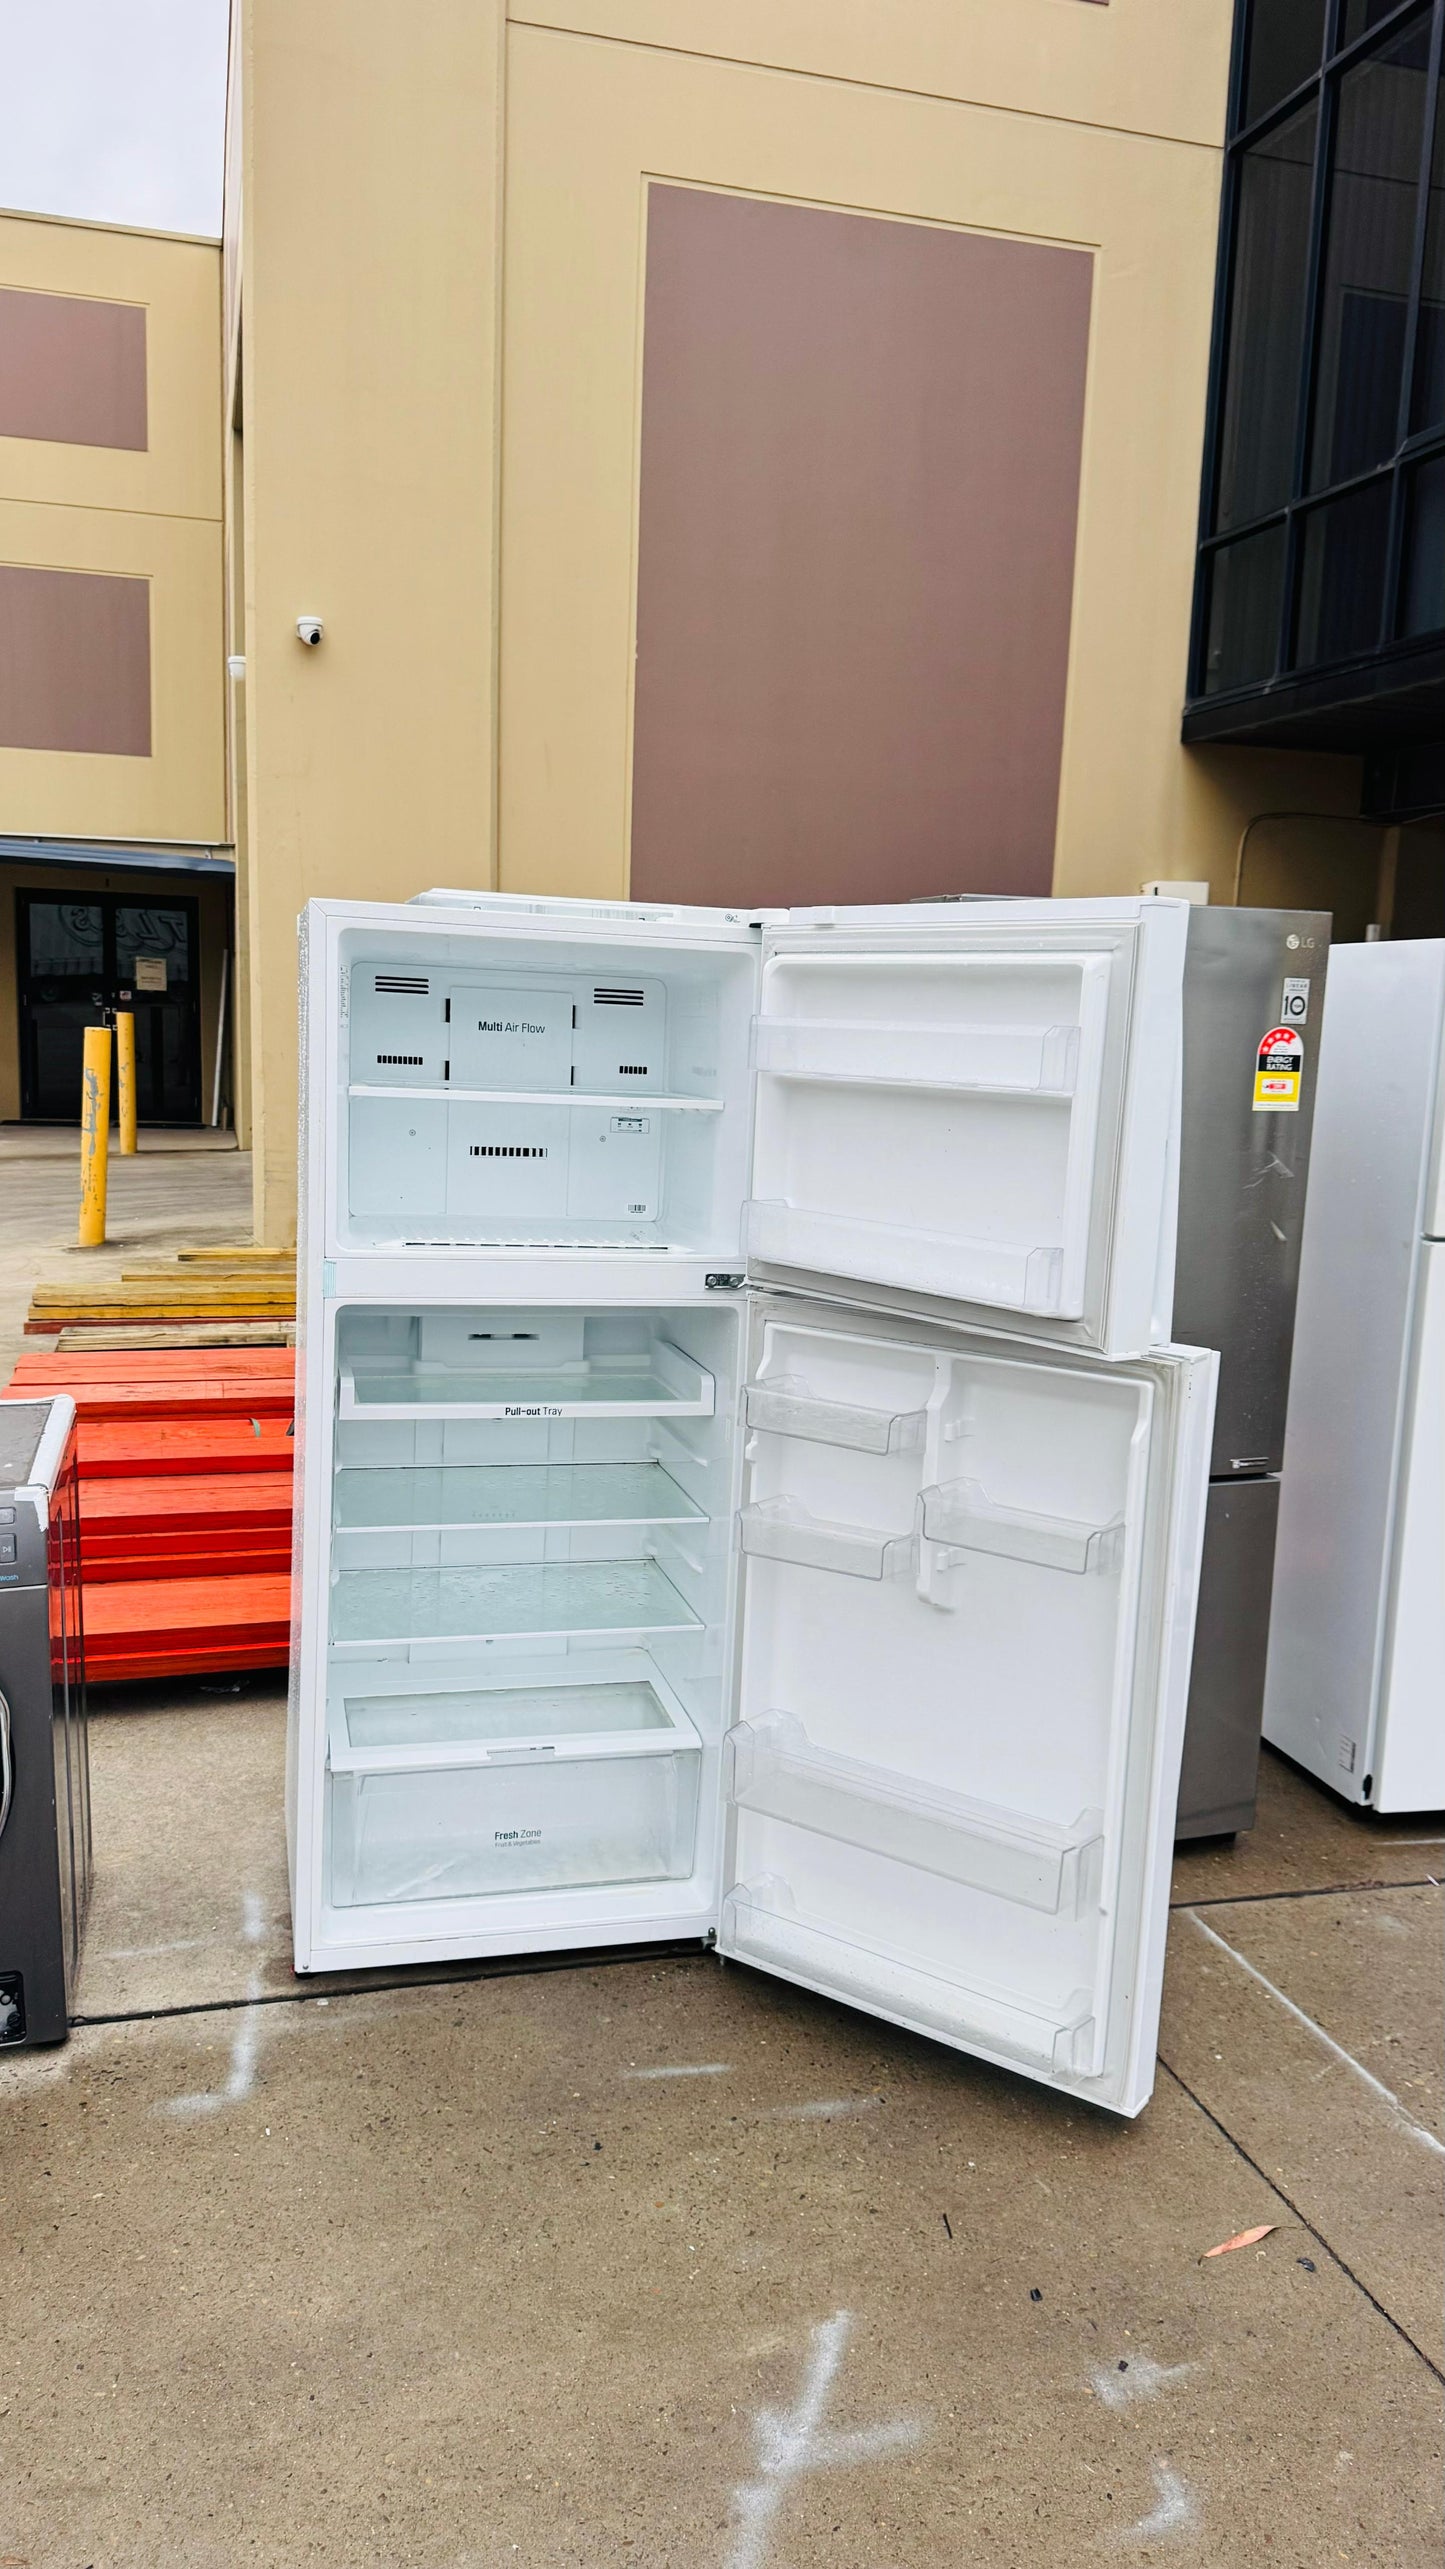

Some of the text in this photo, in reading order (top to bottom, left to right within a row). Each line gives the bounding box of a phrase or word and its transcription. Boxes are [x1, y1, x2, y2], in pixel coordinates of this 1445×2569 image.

[1284, 995, 1306, 1016] 10
[478, 1021, 545, 1033] Multi Air Flow
[1266, 1063, 1293, 1072] RATING
[505, 1406, 563, 1417] Pull-out Tray
[494, 1829, 542, 1840] Fresh Zone
